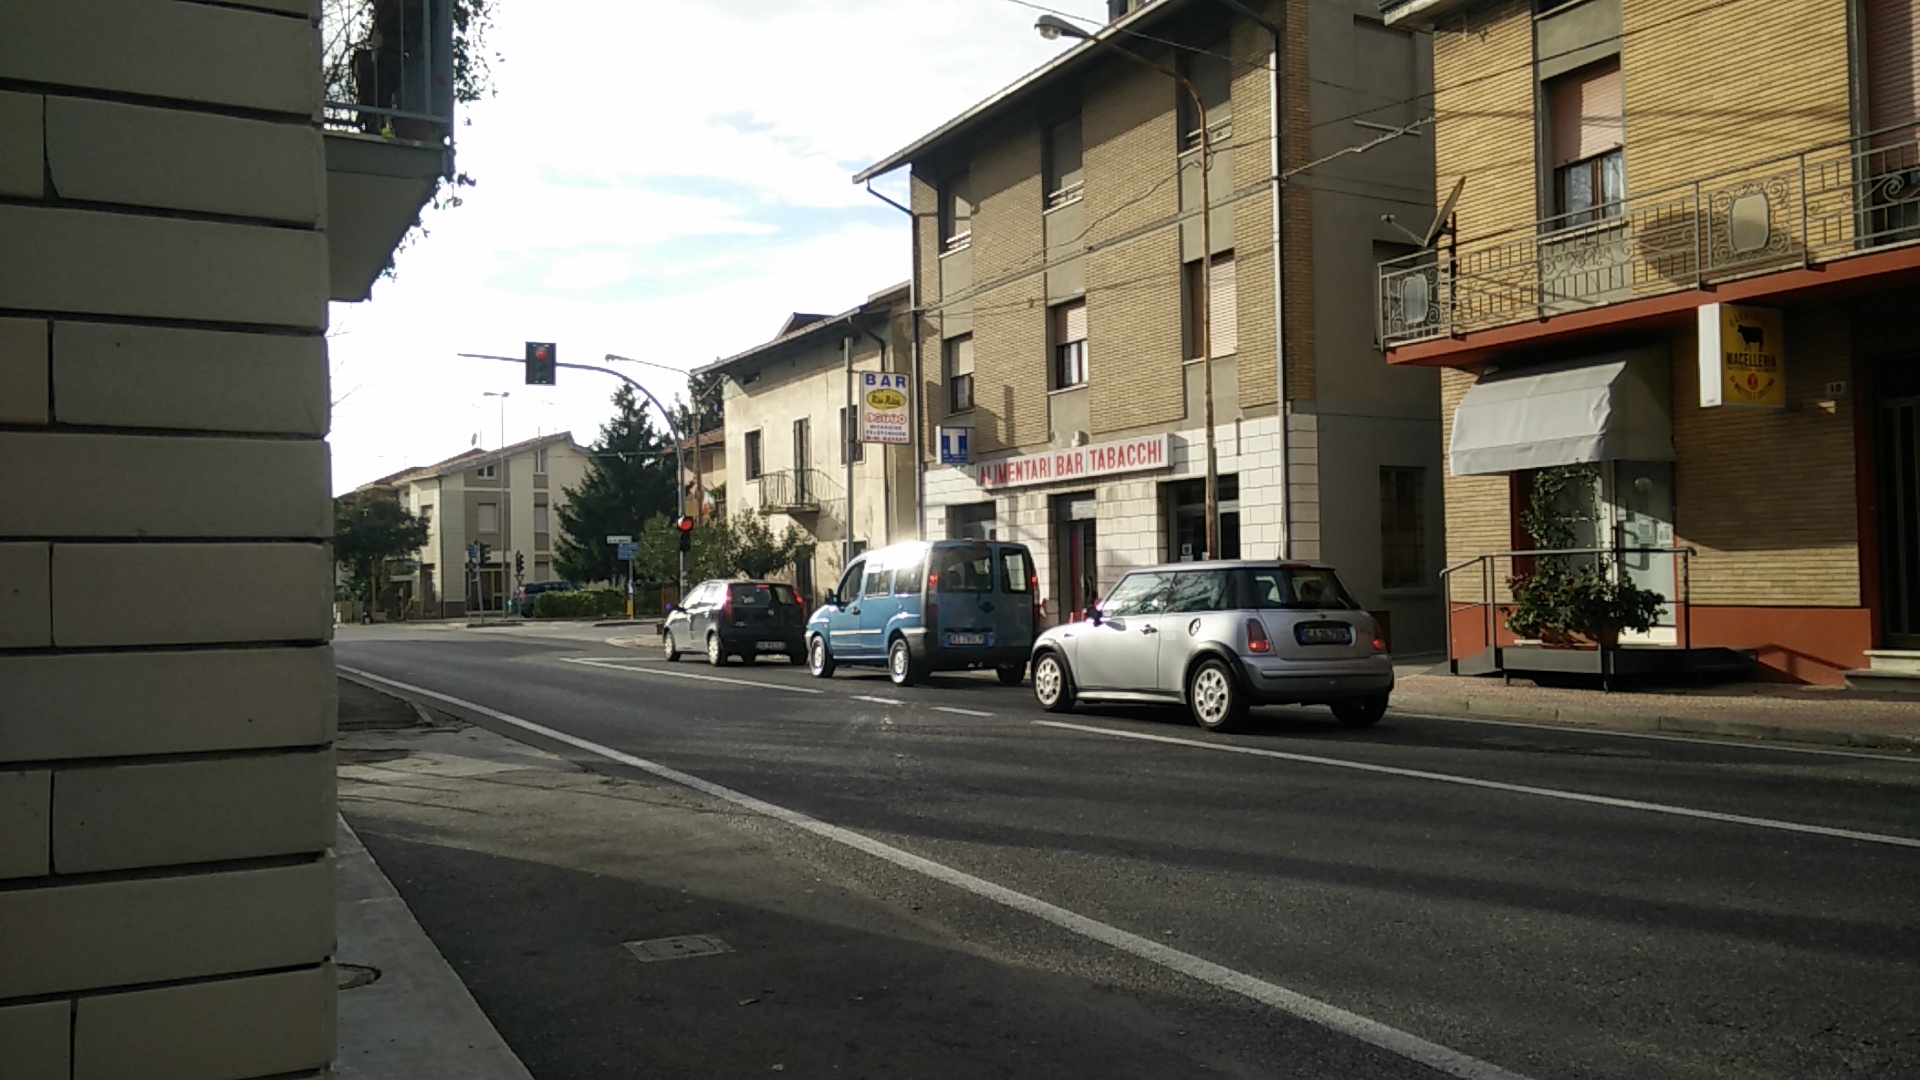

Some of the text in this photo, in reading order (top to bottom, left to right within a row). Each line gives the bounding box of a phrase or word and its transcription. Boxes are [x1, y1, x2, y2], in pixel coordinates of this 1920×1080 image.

[1726, 352, 1776, 367] MACELLERIA
[866, 373, 906, 389] BAR
[942, 428, 966, 455] T
[979, 439, 1162, 487] ALIMENTARI BAR TABACCHI
